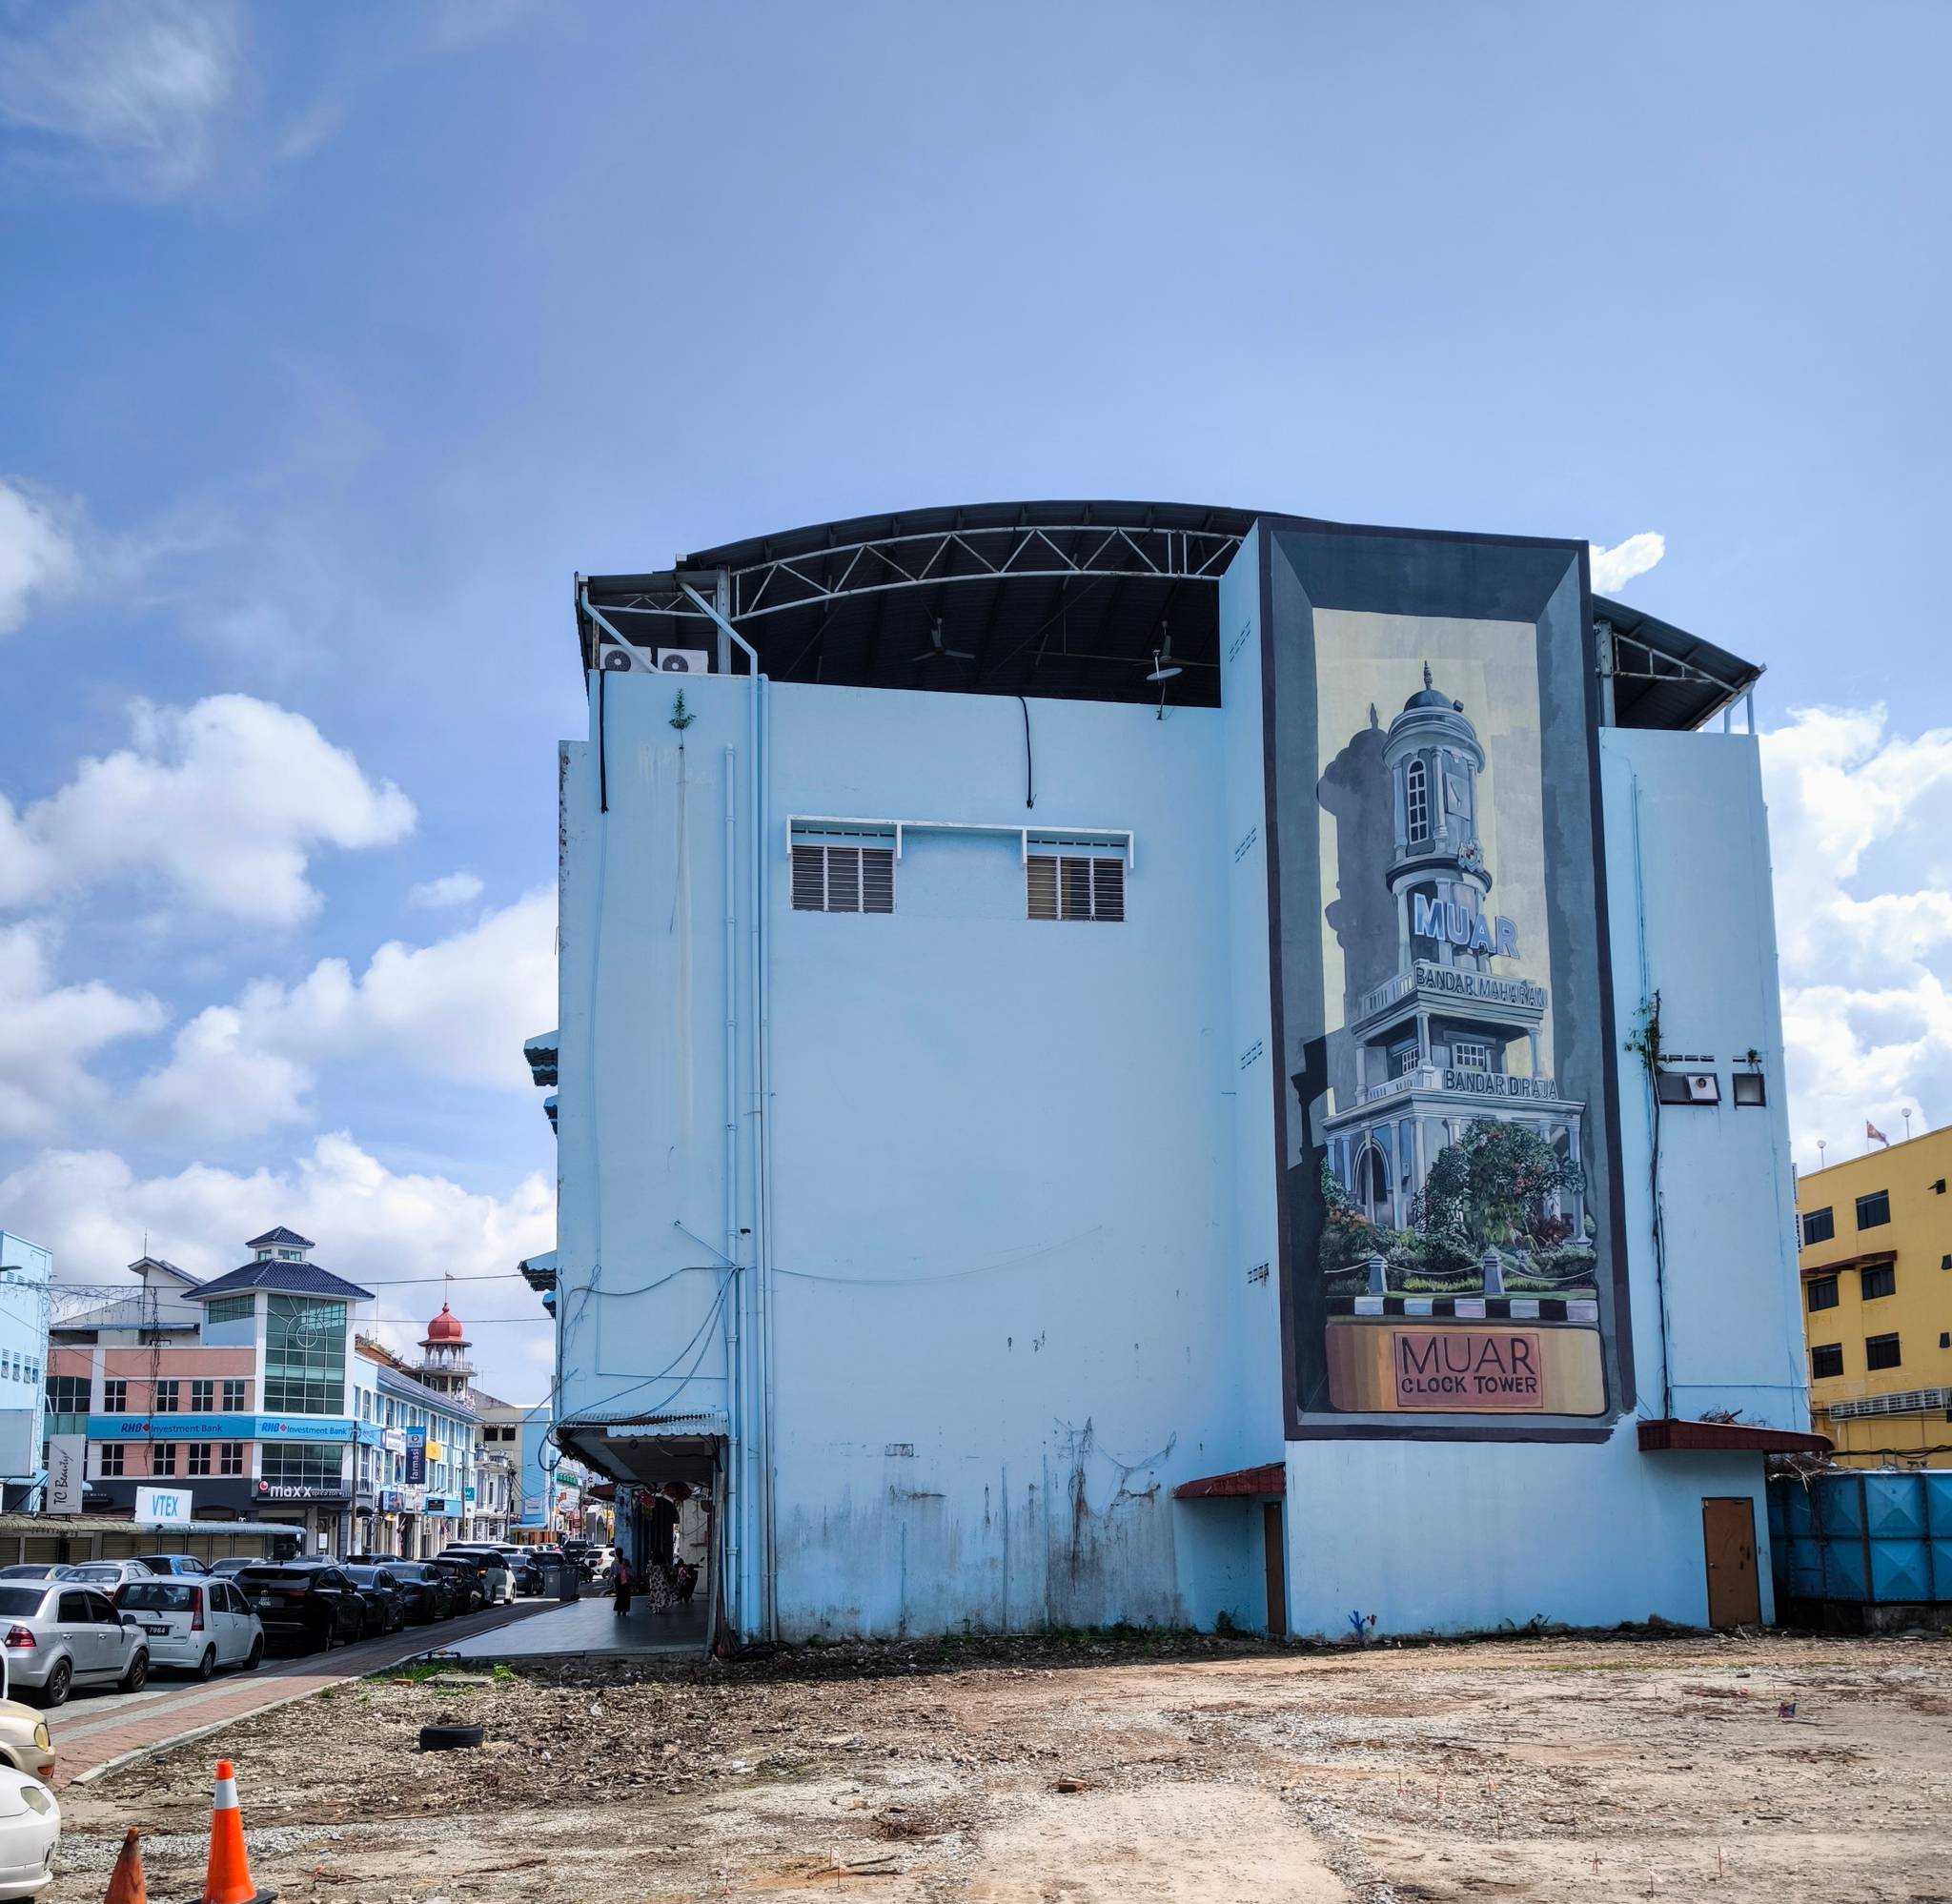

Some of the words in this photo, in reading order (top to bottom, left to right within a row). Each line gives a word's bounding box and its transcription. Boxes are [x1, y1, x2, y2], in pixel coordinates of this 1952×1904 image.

[1414, 893, 1520, 960] MUAR
[1415, 966, 1474, 996] BANDAR
[1445, 1069, 1505, 1096] BANDAR
[1401, 1336, 1536, 1375] MUAR
[1401, 1375, 1468, 1394] CLOCK
[1474, 1375, 1537, 1395] TOWER
[121, 1422, 142, 1433] RHB
[151, 1424, 198, 1433] Investment
[201, 1424, 223, 1433] Bank
[261, 1422, 280, 1433] RHB
[287, 1425, 328, 1435] Investment
[329, 1427, 347, 1436] Bank
[55, 1450, 73, 1489] Beauty
[411, 1448, 419, 1480] farmasi
[53, 1491, 68, 1506] TC
[152, 1494, 179, 1517] VTEX
